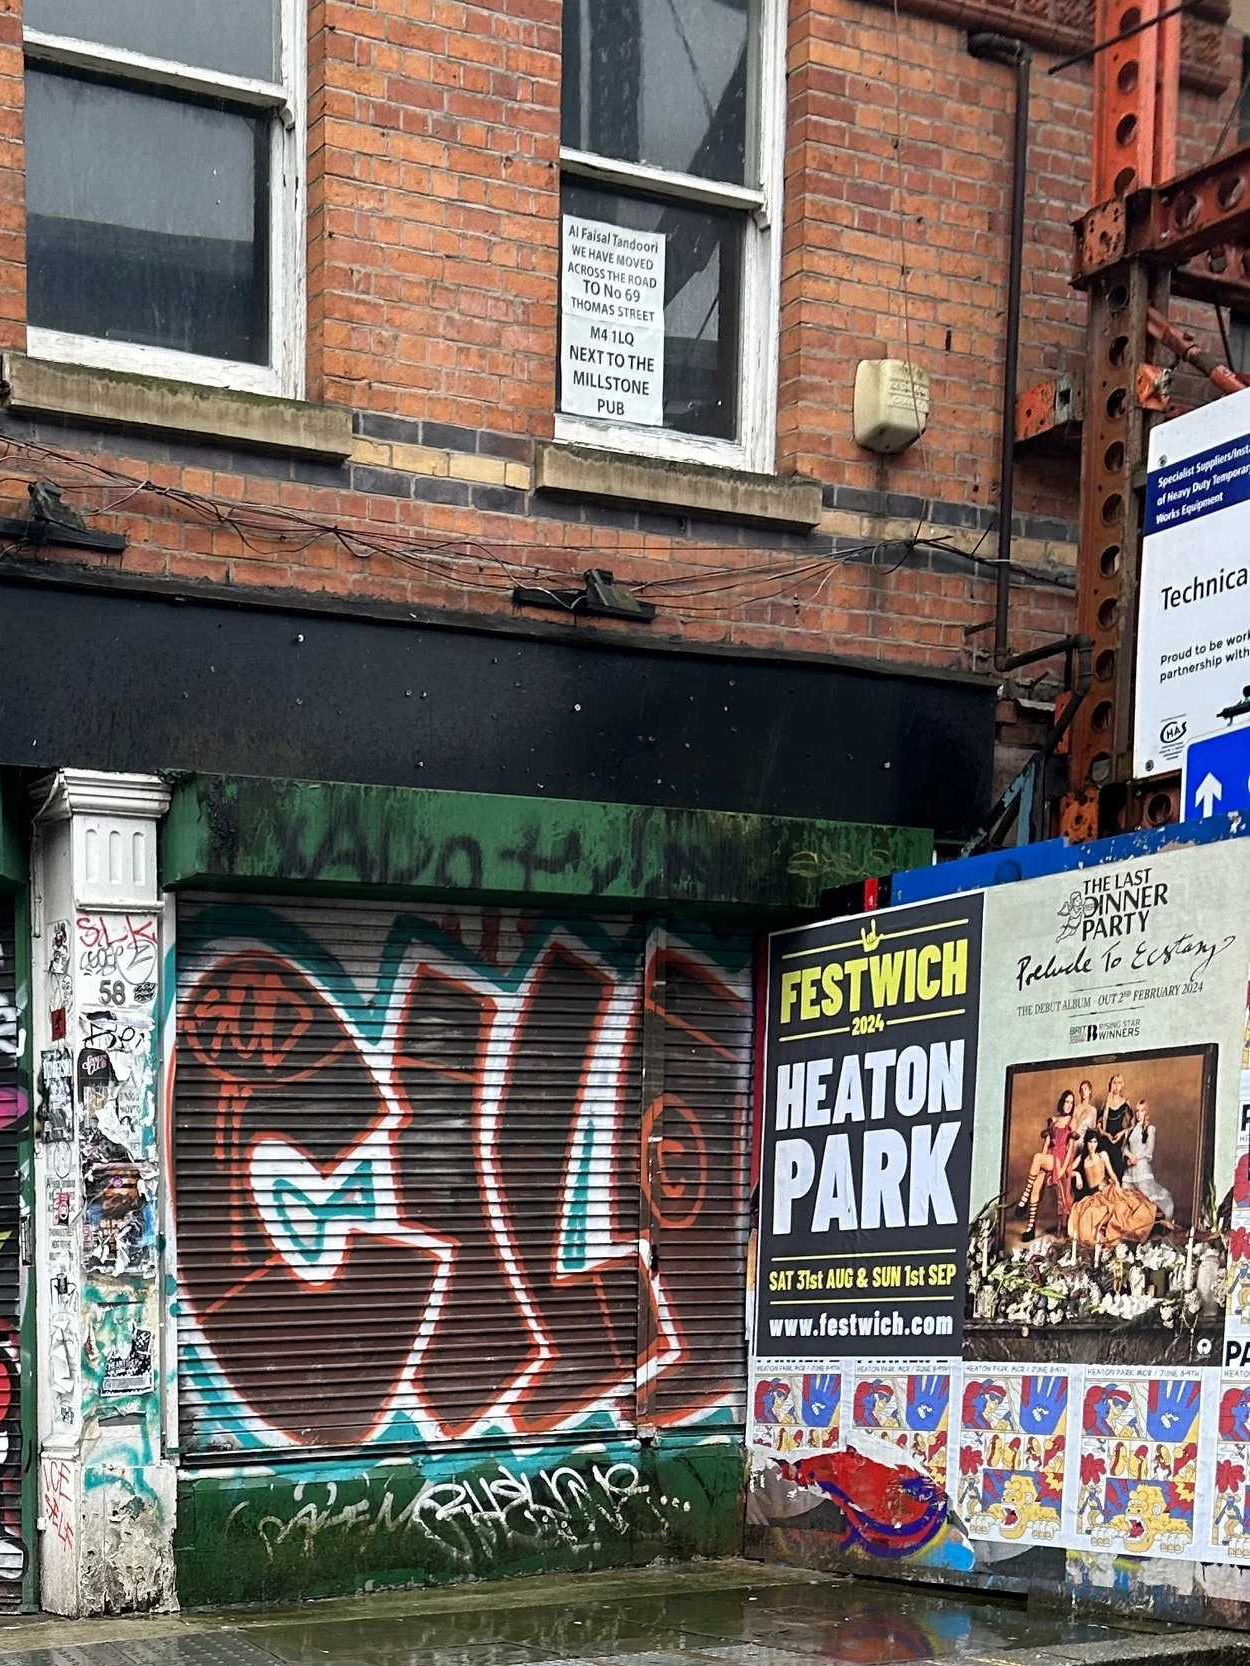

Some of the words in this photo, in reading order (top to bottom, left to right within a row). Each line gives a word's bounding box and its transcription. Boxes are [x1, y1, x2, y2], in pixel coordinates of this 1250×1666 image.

[569, 224, 579, 238] Al
[581, 228, 610, 244] Faisal
[612, 234, 658, 253] Tandoori
[572, 244, 587, 258] WE
[588, 248, 614, 264] HAVE
[616, 254, 654, 270] MOVED
[568, 261, 605, 279] ACROSS
[607, 270, 626, 284] THE
[628, 274, 657, 289] ROAD
[583, 279, 600, 295] TO
[604, 284, 621, 299] No
[625, 289, 641, 303] 69
[571, 296, 615, 316] THOMAS
[618, 306, 655, 322] STREET
[590, 325, 608, 341] M4
[611, 330, 634, 347] 1LQ
[569, 344, 604, 365] NEXT
[606, 352, 625, 368] TO
[628, 355, 655, 372] THE
[573, 370, 650, 396] MILLSTONE
[597, 398, 625, 416] PUB
[1158, 465, 1194, 488] Specialist
[1157, 495, 1166, 506] of
[1167, 487, 1191, 503] Heavy
[1192, 478, 1211, 493] Duty
[1156, 508, 1180, 524] Works
[1182, 492, 1223, 516] Equipment
[1161, 568, 1248, 611] Technica
[1160, 656, 1222, 684] partnership
[1225, 647, 1250, 662] with
[1161, 647, 1192, 665] Proud
[1195, 645, 1206, 656] to
[1209, 640, 1223, 652] be
[1083, 875, 1111, 895] THE
[1115, 868, 1152, 889] LAST
[1083, 883, 1169, 918] DINNER
[1082, 910, 1150, 941] PARTY
[1016, 946, 1092, 991] Prelude
[1101, 941, 1121, 972] To
[99, 980, 125, 1005] 58
[780, 938, 968, 1024] FESTWICH
[1016, 1006, 1033, 1017] THE
[1034, 1001, 1061, 1015] DEBUT
[1061, 997, 1091, 1011] ALBUM
[1097, 994, 1117, 1006] OUT
[1133, 984, 1180, 1001] FEBRUARY
[1181, 981, 1204, 995] 2024
[851, 1014, 884, 1036] 2024
[1099, 1027, 1140, 1040] WINNERS
[1123, 1019, 1141, 1027] STAR
[776, 1039, 965, 1131] HEATON
[772, 1121, 962, 1235] PARK
[769, 1270, 794, 1291] SAT
[797, 1269, 823, 1290] 31st
[826, 1268, 853, 1289] AUG
[856, 1267, 868, 1288] &
[872, 1266, 901, 1288] SUN
[904, 1264, 925, 1286] 1st
[928, 1264, 957, 1286] SEP
[769, 1310, 954, 1337] www.festwich.com
